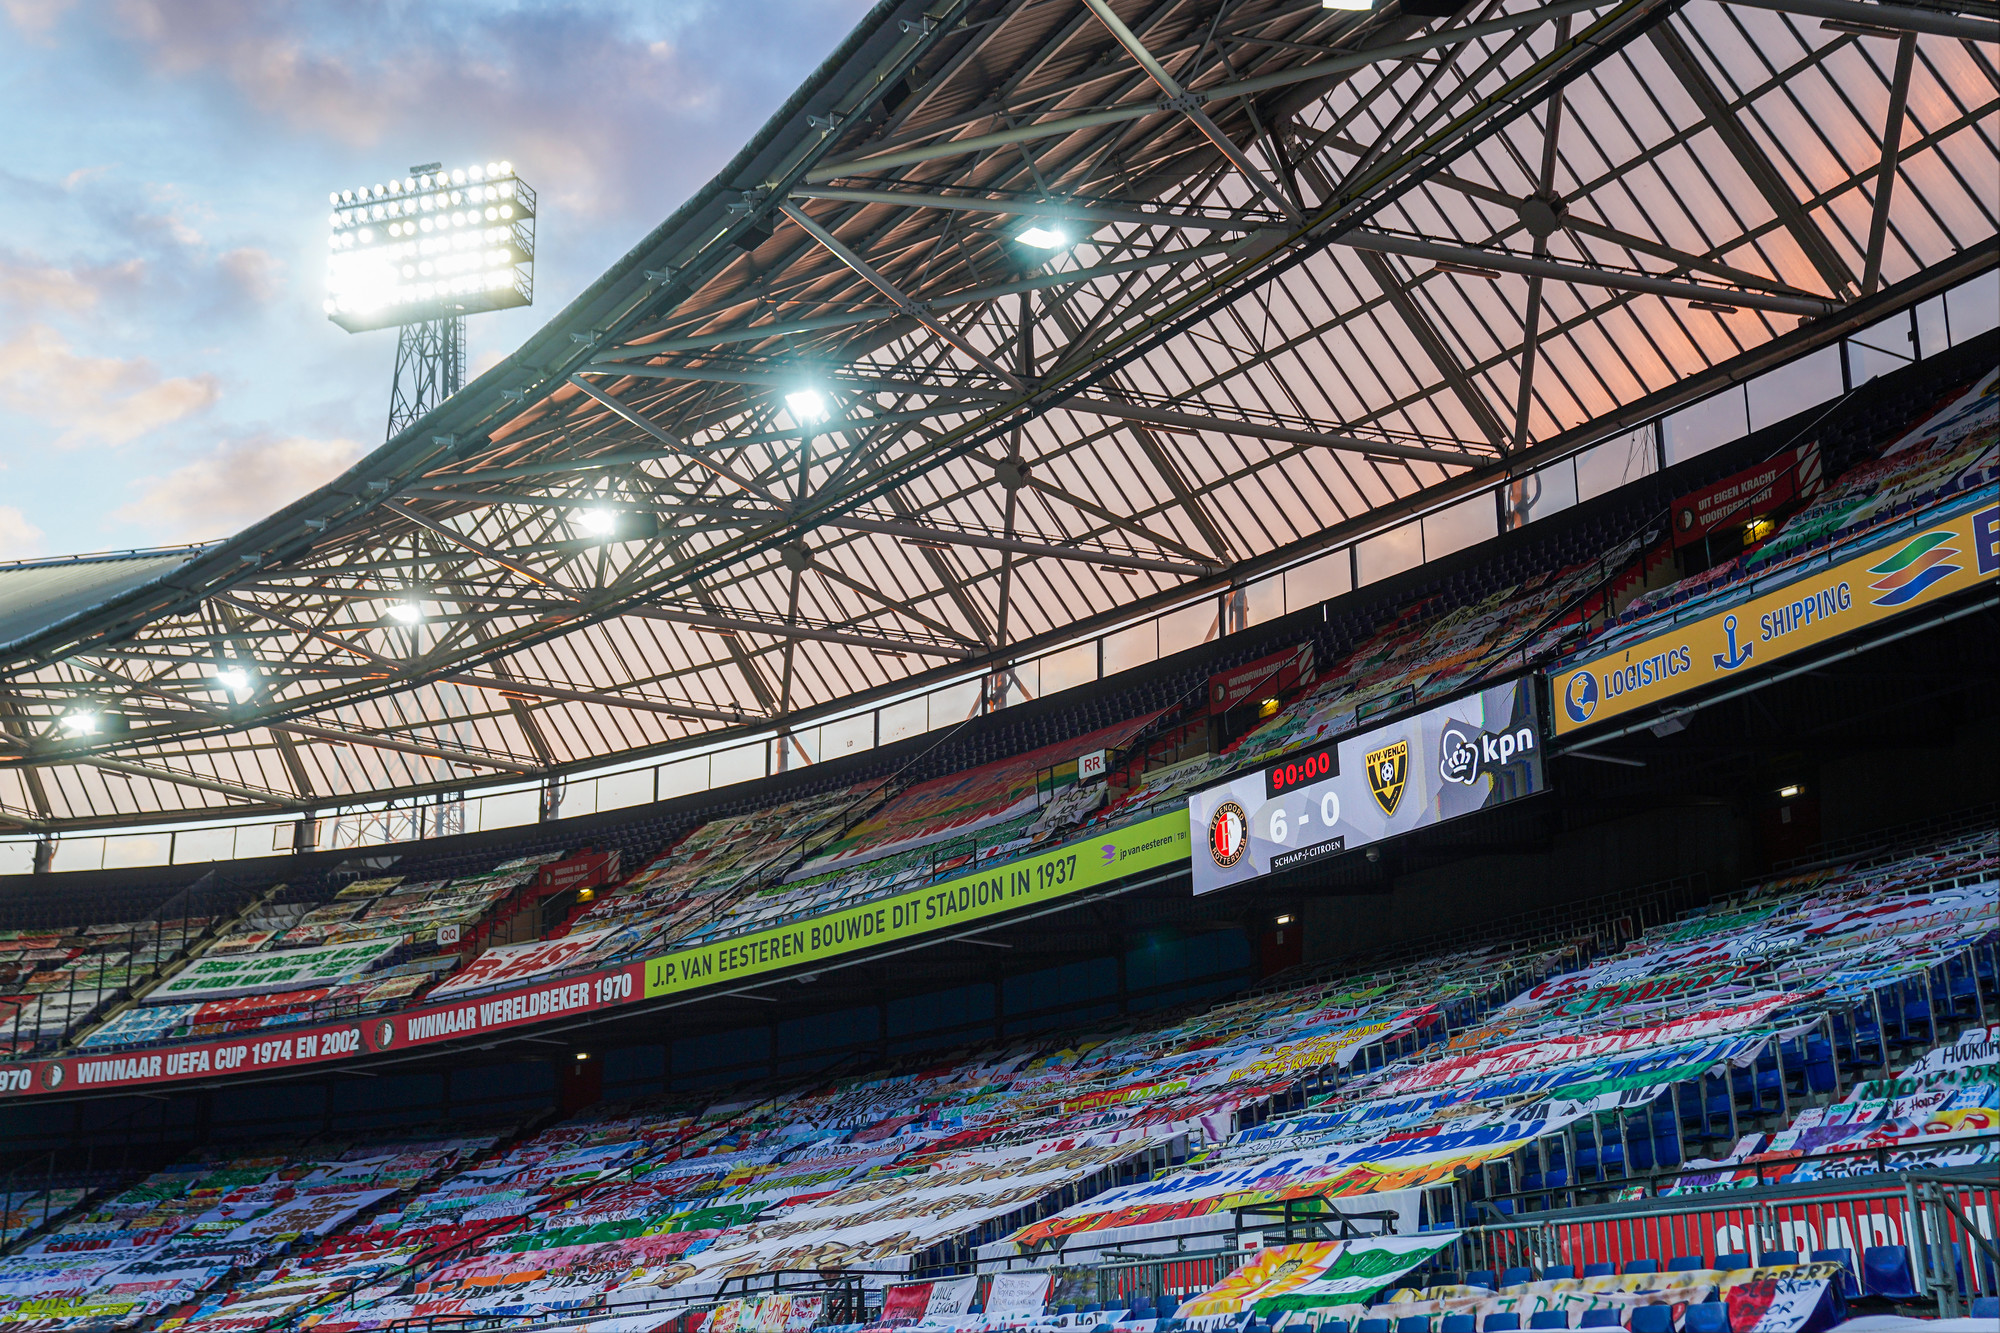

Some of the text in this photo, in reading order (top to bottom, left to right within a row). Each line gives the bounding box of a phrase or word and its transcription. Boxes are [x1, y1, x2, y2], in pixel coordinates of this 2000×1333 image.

[1698, 470, 1776, 510] UIT EIGEN KRACHT
[1604, 581, 1852, 700] LOGISTICS SHIPPING
[1229, 685, 1251, 700] TROUW
[1084, 756, 1100, 773] RR
[1366, 744, 1406, 764] VVV-VENLO
[1482, 728, 1533, 765] kpn
[1272, 752, 1330, 790] 90:00
[1211, 803, 1244, 831] FEYENOORD
[1270, 808, 1288, 843] 6
[1321, 791, 1340, 827] 0
[1119, 848, 1127, 861] jp
[1127, 844, 1140, 856] van
[1141, 834, 1173, 852] eesteren
[1212, 838, 1246, 865] ROTTERDAM
[441, 929, 456, 941] QQ
[652, 855, 1077, 987] J.P. VAN EESTEREN BOUWDE DIT STADION IN 1937
[408, 972, 632, 1041] WINNAAR WERELDBEKER 1970
[77, 1055, 161, 1084] WINNAAR
[166, 1051, 210, 1075] UEFA
[215, 1046, 247, 1070] CUP
[252, 1039, 292, 1065] 1974
[297, 1035, 318, 1060] EN
[322, 1028, 360, 1055] 2002
